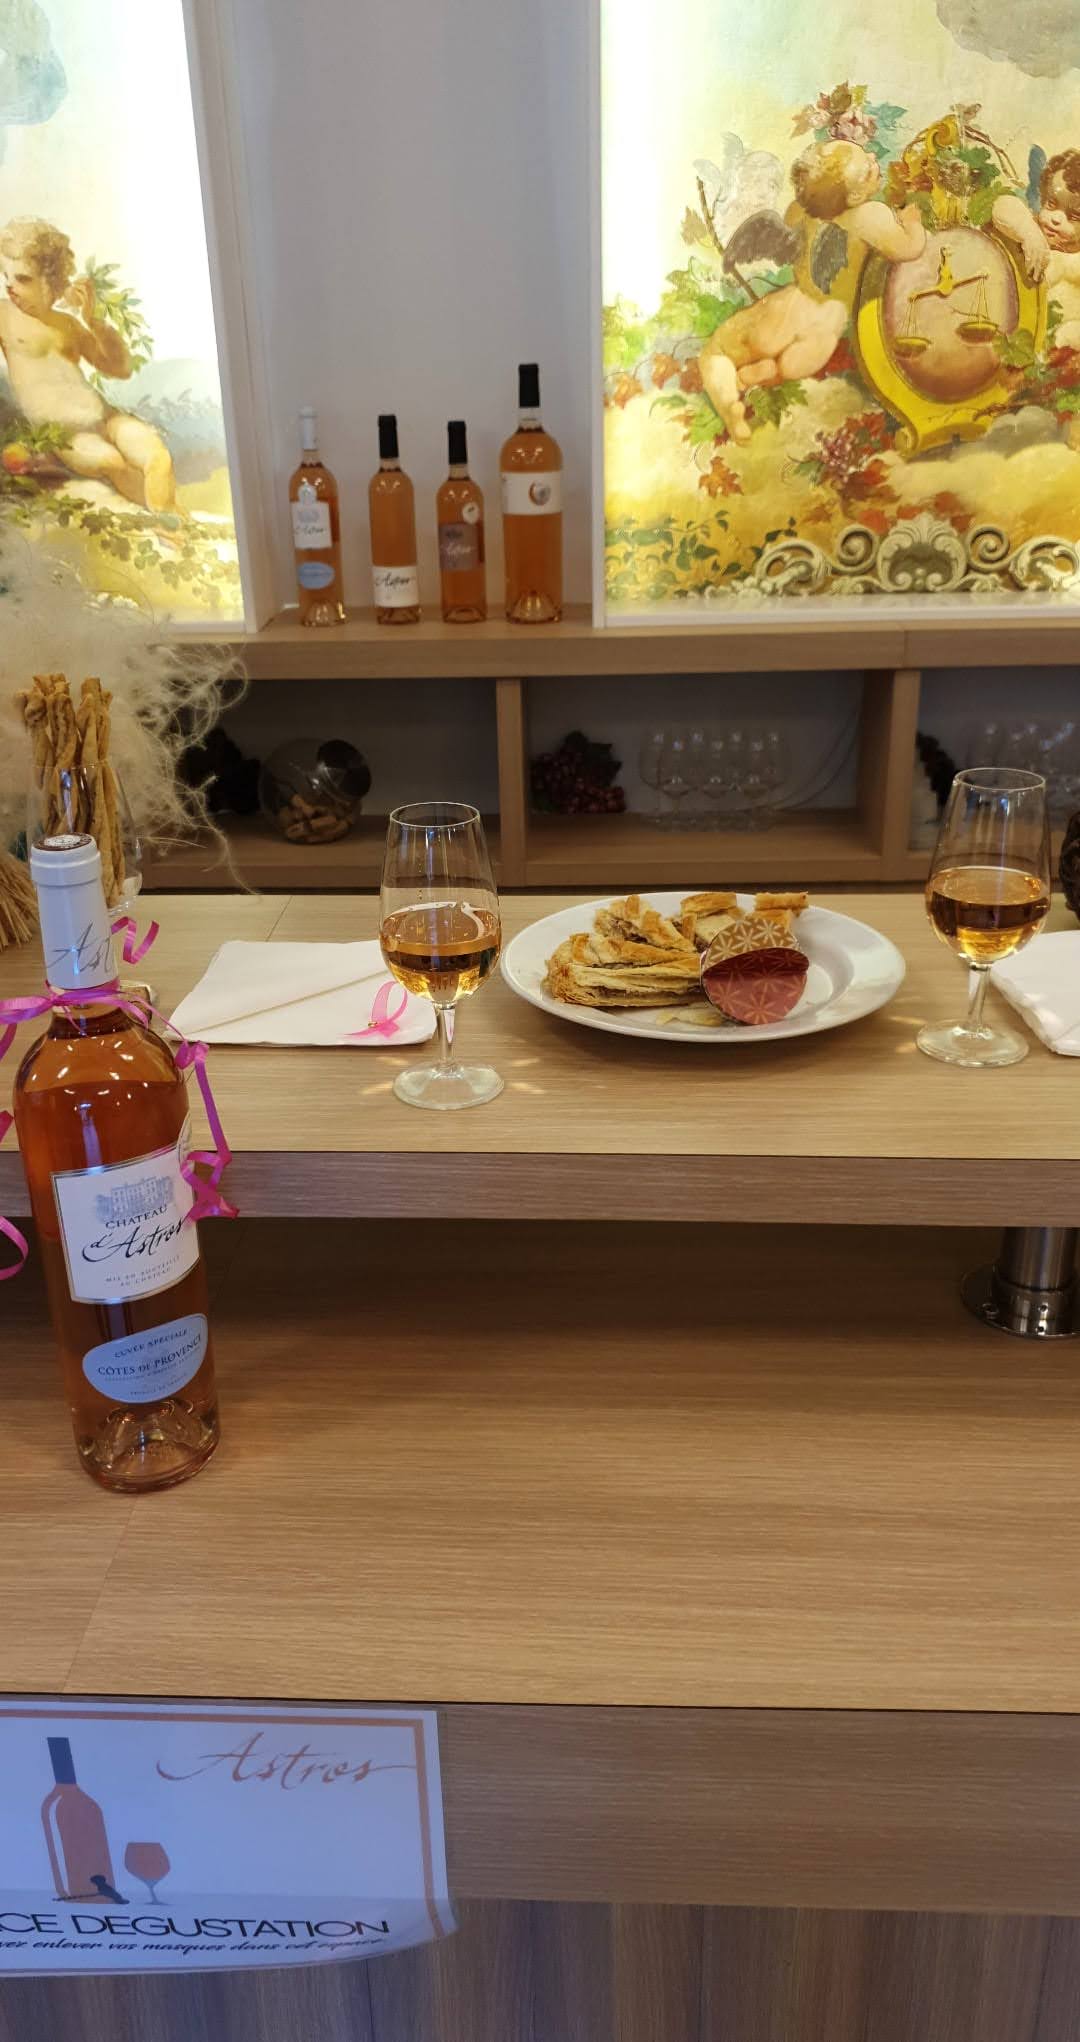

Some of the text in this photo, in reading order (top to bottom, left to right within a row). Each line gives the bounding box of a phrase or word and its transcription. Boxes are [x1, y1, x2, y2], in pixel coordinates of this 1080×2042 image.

[156, 1731, 416, 1789] Astros
[0, 1912, 390, 1938] CE DEGUSTATION
[33, 1938, 102, 1949] enlever
[109, 1943, 137, 1951] vos
[143, 1943, 226, 1955] masques
[229, 1941, 280, 1951] dans
